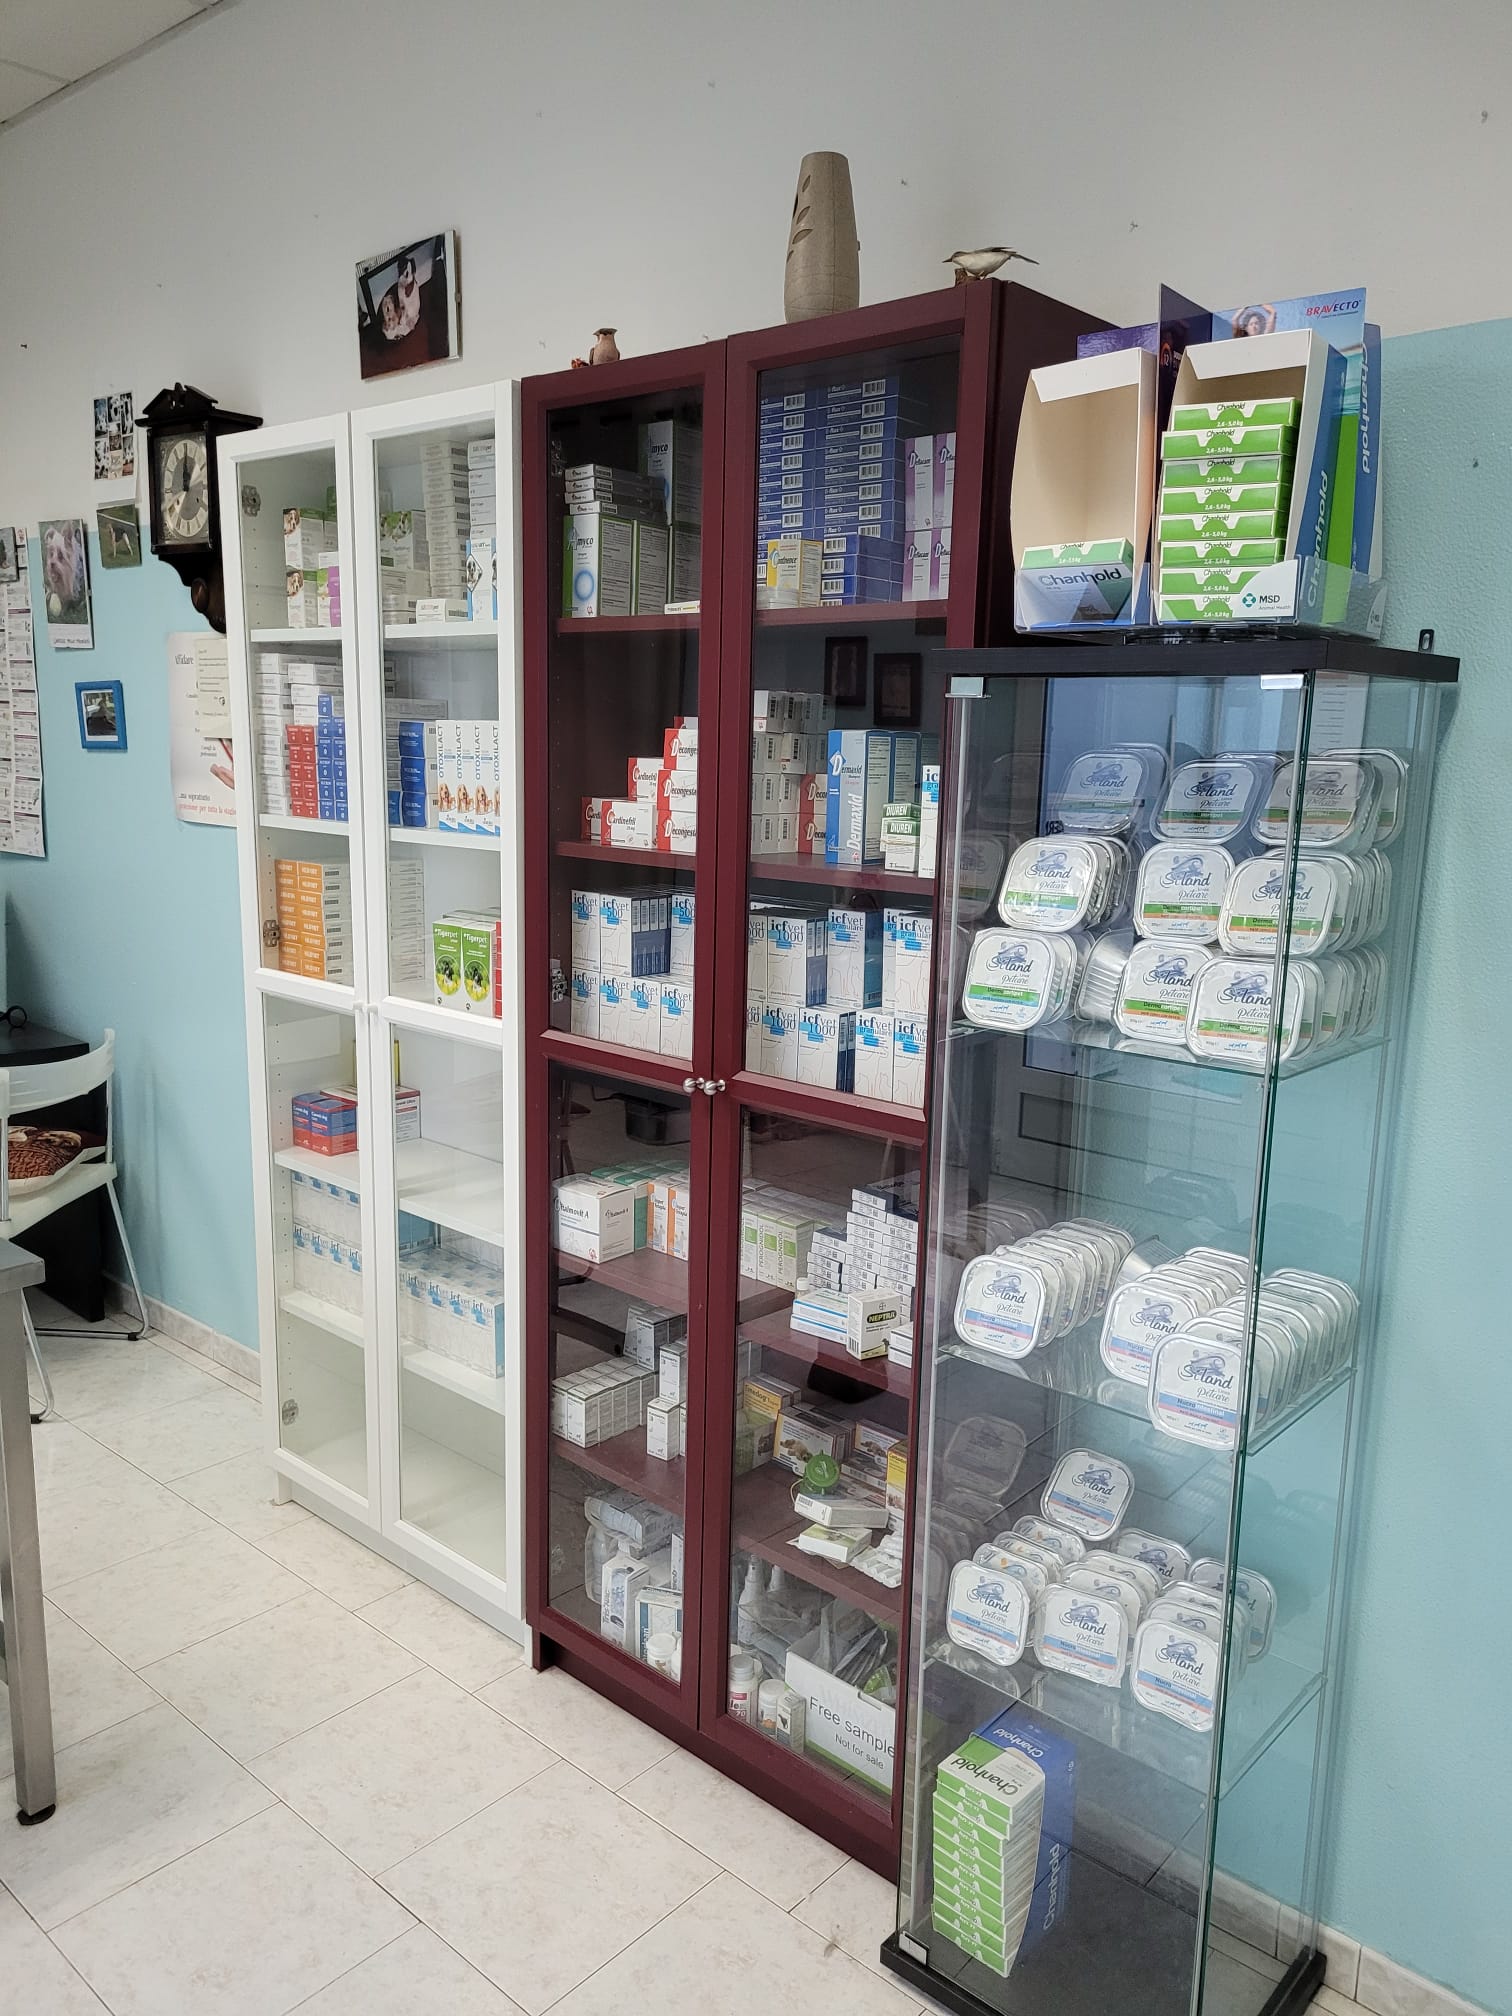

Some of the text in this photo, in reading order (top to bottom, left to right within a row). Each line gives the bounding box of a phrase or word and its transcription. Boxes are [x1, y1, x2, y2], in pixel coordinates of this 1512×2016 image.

[1306, 300, 1360, 317] BRAVECTO
[1308, 471, 1328, 608] Chanhold
[1039, 568, 1122, 587] Chanhold
[1259, 595, 1280, 604] MSD
[832, 752, 863, 777] Dermaxid
[846, 794, 863, 851] Dermaxid
[886, 804, 908, 817] DIUREN
[890, 822, 913, 834] DIUREN
[809, 1696, 896, 1759] Free sample
[835, 1732, 885, 1770] Not for sale
[992, 1728, 1044, 1759] Chanhold
[950, 1757, 1019, 1796] Chanhold
[1042, 1842, 1061, 1932] Chanhold
